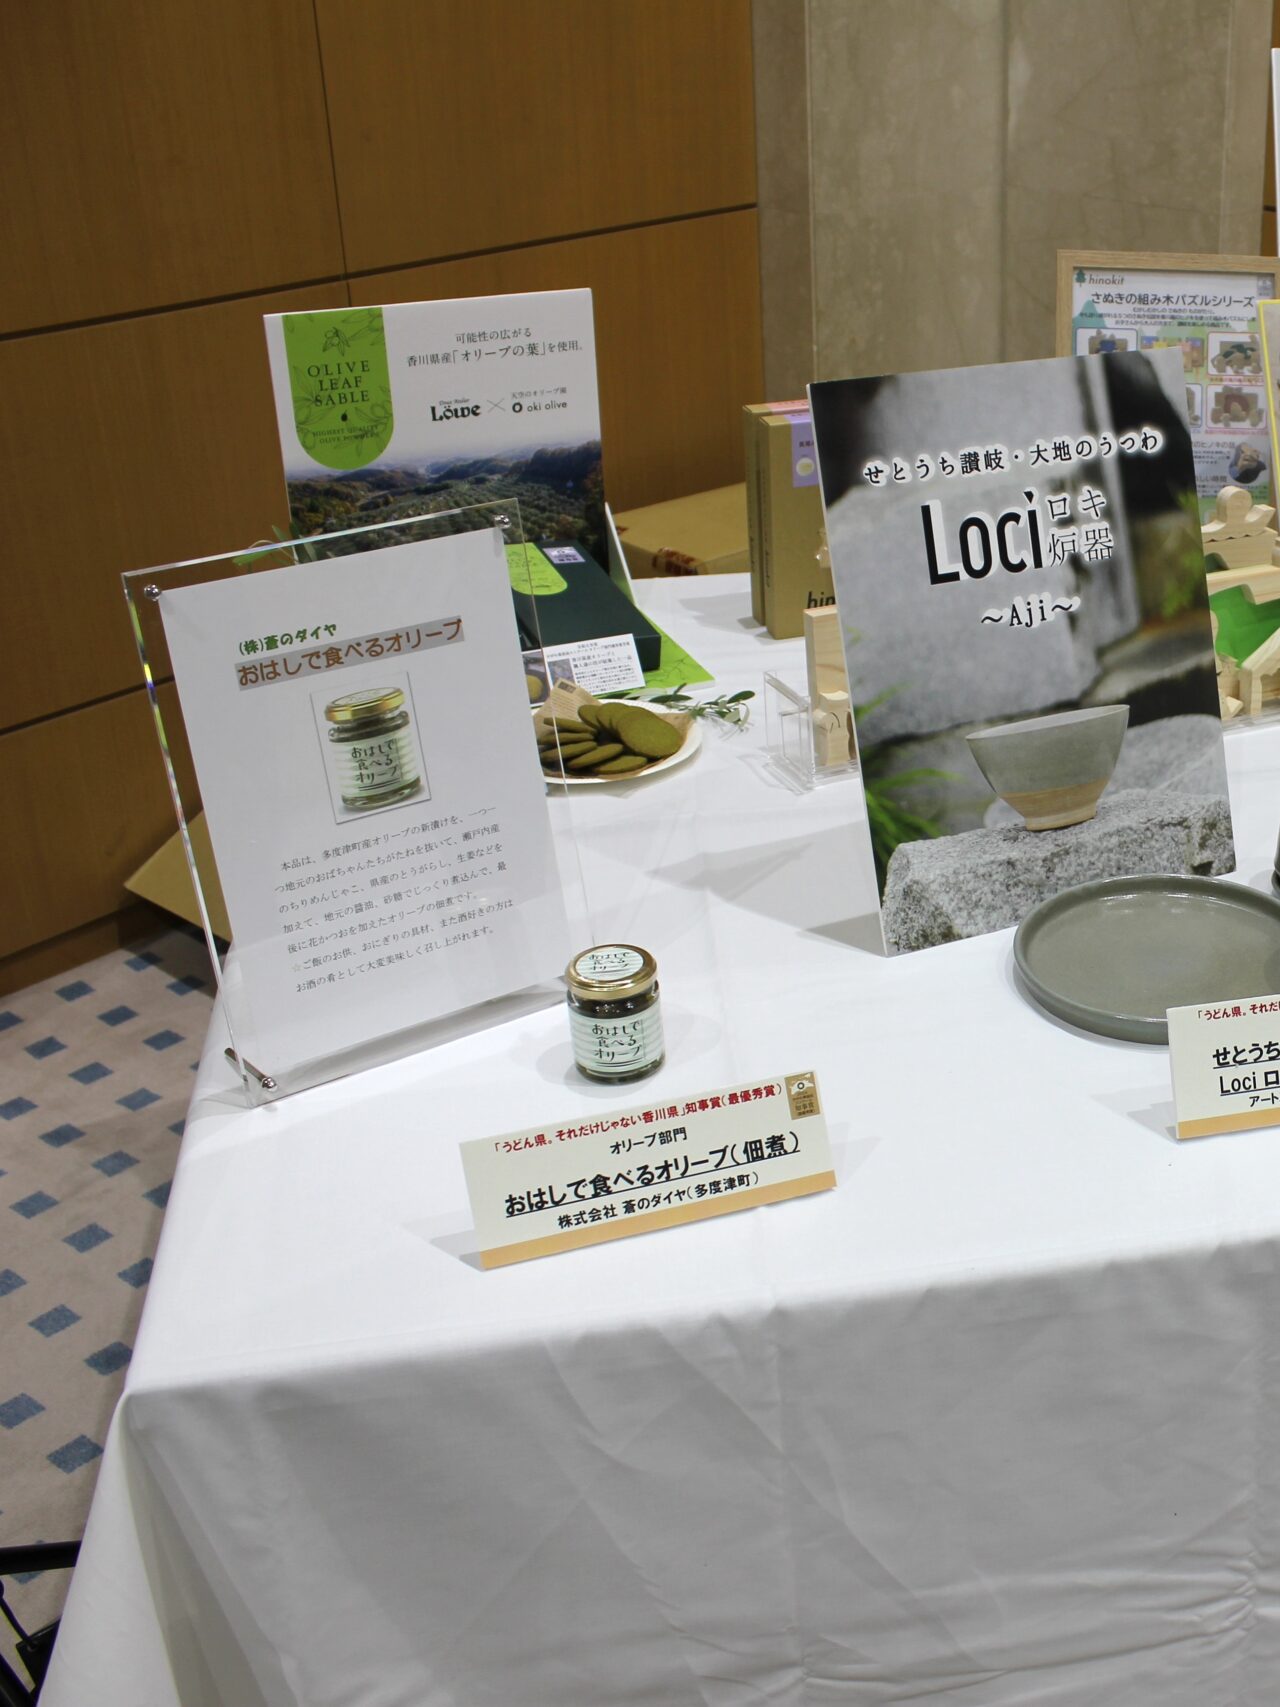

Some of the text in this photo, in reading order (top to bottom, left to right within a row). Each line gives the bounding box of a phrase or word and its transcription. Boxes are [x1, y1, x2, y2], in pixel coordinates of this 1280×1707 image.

[1088, 274, 1125, 286] hinokit
[1091, 292, 1255, 308] さぬきの組み木パズルシリーズ
[455, 327, 532, 344] 可能性の広がる
[407, 340, 583, 367] 香川県産「オリーブの葉」を使用。
[307, 360, 370, 377] OLIVE
[319, 376, 362, 391] LEAF
[314, 390, 370, 407] SABLE
[545, 400, 567, 410] olive
[864, 430, 1160, 485] せとうち讃岐・大地のうつわ
[1048, 490, 1106, 519] ロキ
[921, 491, 1044, 585] Loci
[1048, 527, 1114, 567] 炉器
[237, 618, 463, 687] おはしで食べるオリーブ
[352, 739, 394, 758] おはしで
[356, 754, 393, 770] 食べる
[592, 1021, 640, 1036] おはしで
[597, 1035, 637, 1048] 食べる
[1220, 1072, 1257, 1095] Loci
[610, 1127, 687, 1155] オリーブ部門
[557, 1204, 618, 1229] 株式会社
